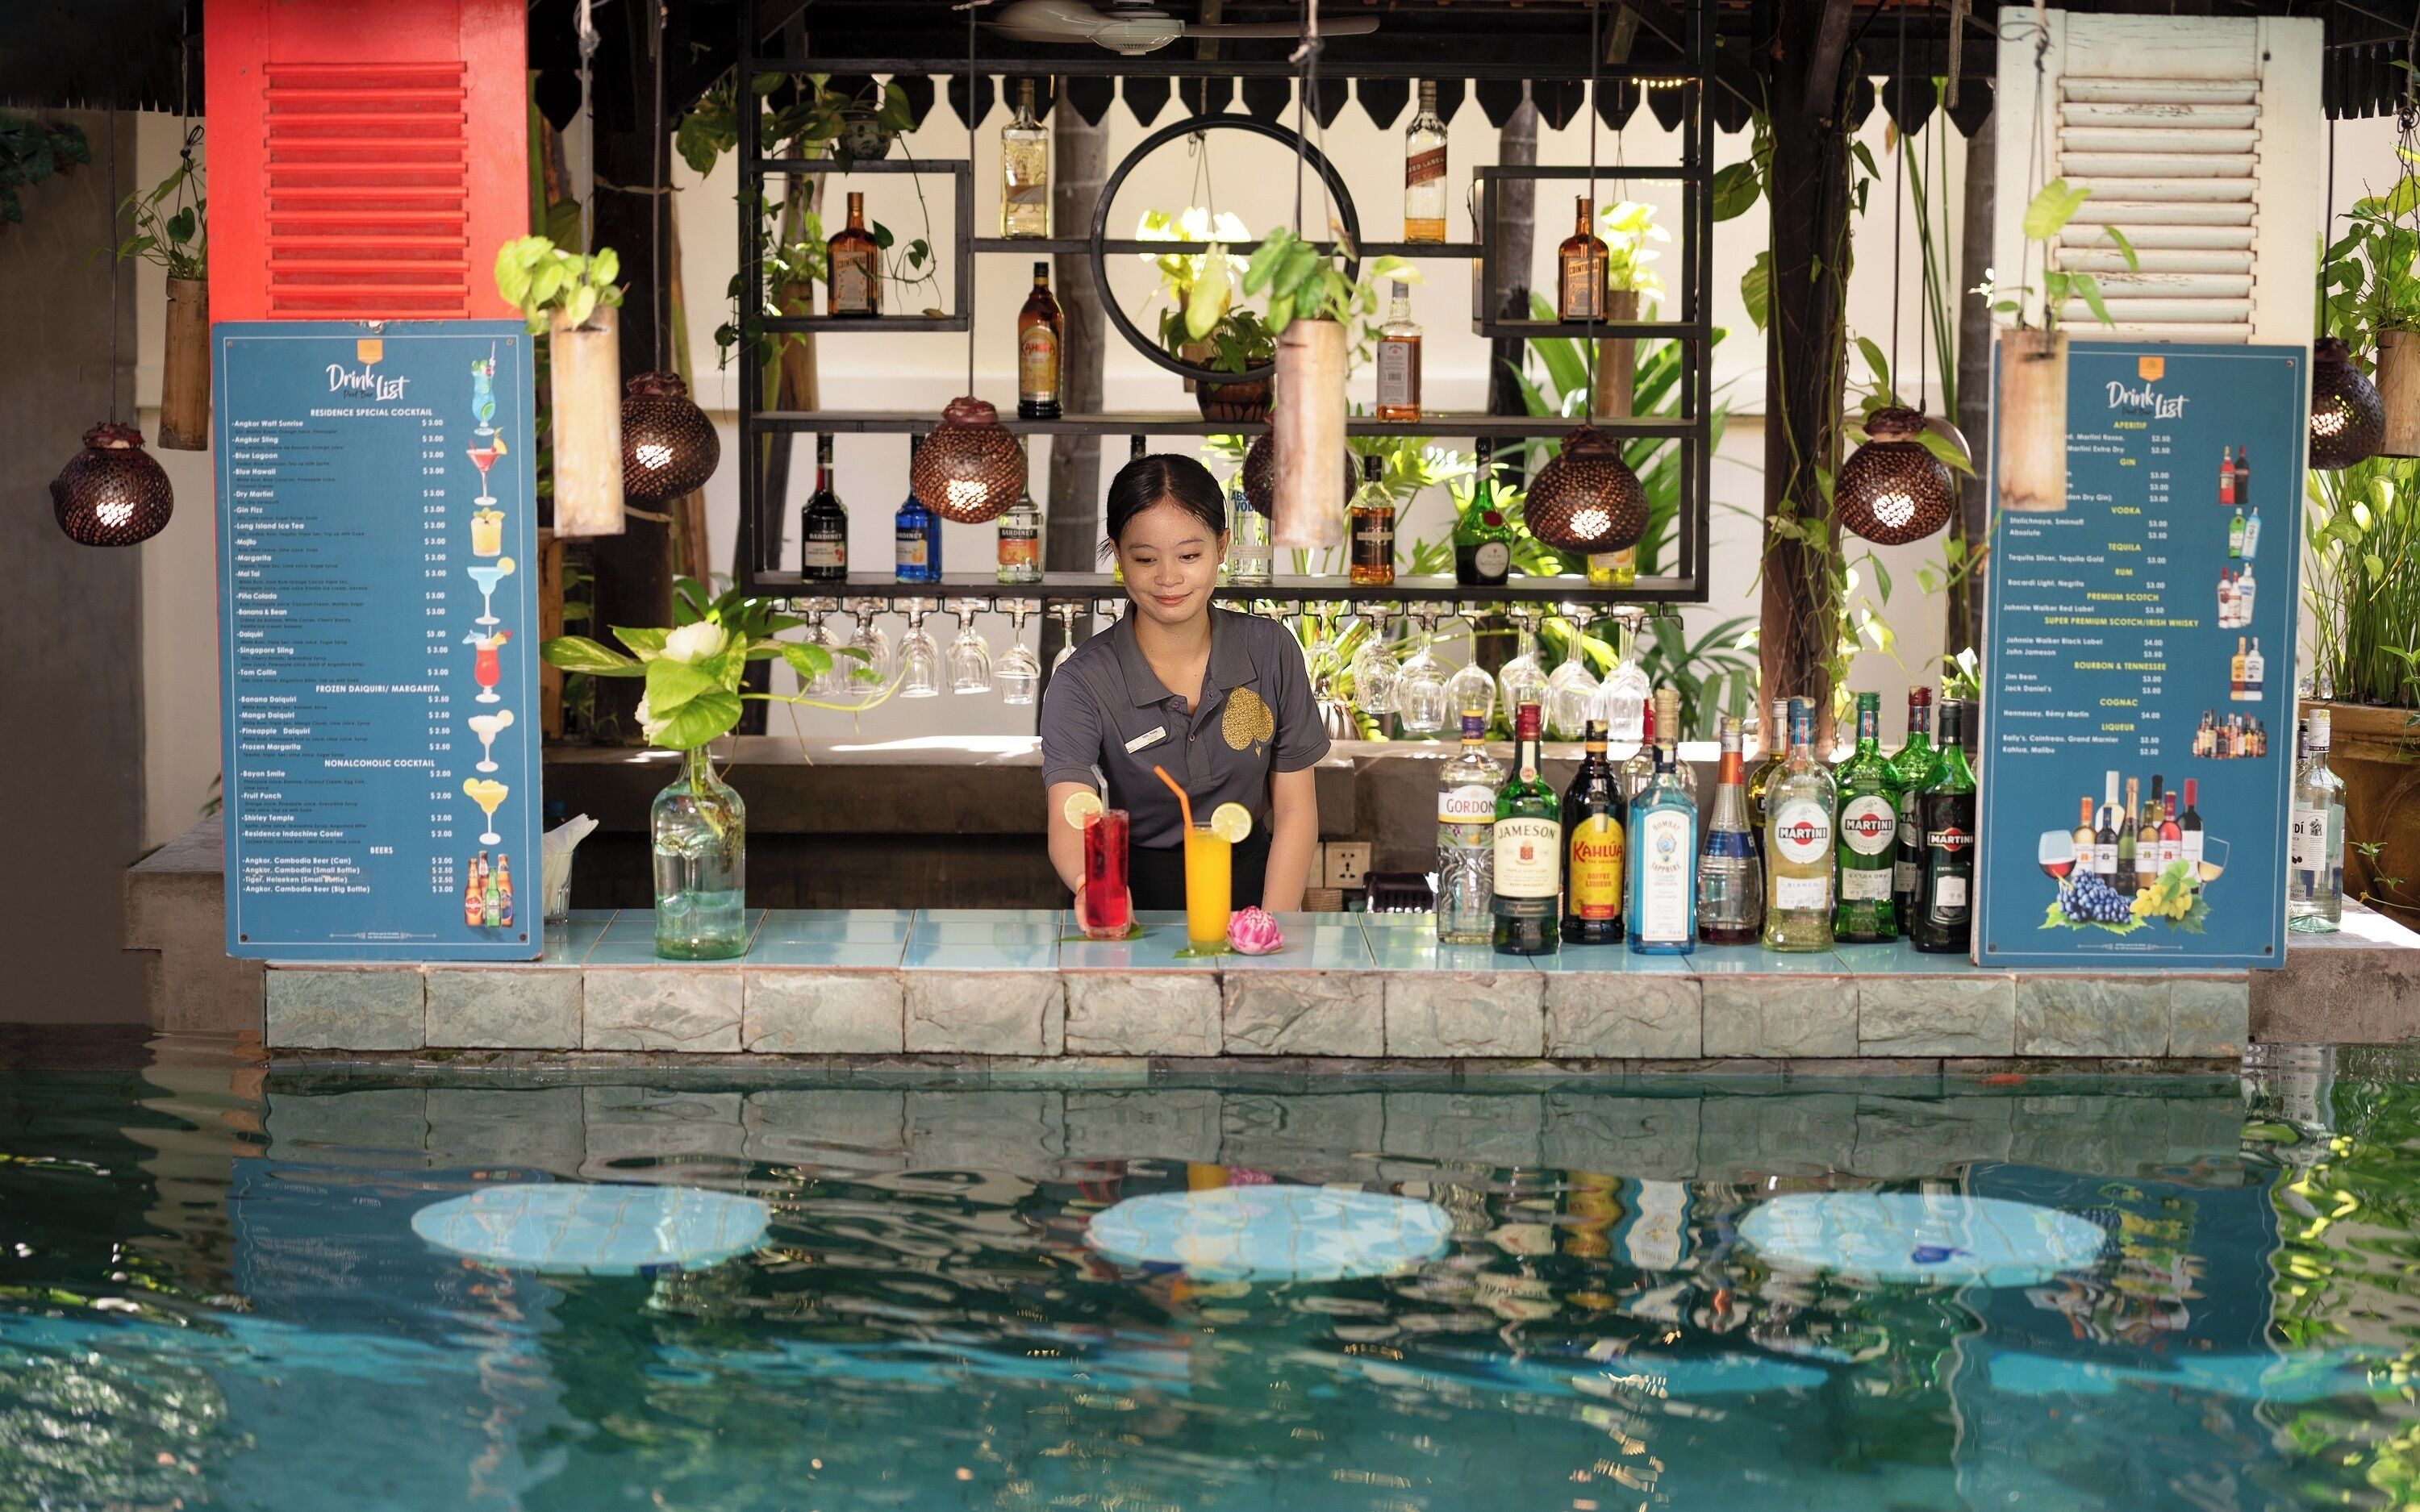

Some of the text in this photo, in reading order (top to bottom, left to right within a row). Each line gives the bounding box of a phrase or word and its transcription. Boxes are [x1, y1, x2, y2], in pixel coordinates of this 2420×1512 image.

[1422, 156, 1444, 168] LABEL
[1568, 261, 1599, 275] COINTRAU
[326, 364, 411, 402] Drink List
[2105, 381, 2190, 419] Drink List
[2113, 421, 2147, 429] APERITIF
[2119, 458, 2136, 466] GIN
[1234, 501, 1255, 512] VOD
[809, 532, 842, 540] BARDINET
[1001, 529, 1034, 537] BARDINET
[2059, 555, 2085, 563] Tequila
[2071, 618, 2107, 626] PREMIUM
[277, 647, 294, 655] Sling
[2074, 661, 2114, 669] BOURBON
[2100, 698, 2138, 706] COGNAC
[283, 727, 311, 735] Daiquiri
[266, 744, 301, 752] Margarita
[269, 814, 294, 823] Temple
[1652, 819, 1681, 831] BOMBAY
[1846, 819, 1892, 831] MARTINI
[1498, 824, 1556, 840] JAMESON
[1780, 827, 1827, 839] MARTINI
[1930, 835, 1974, 844] MARTINI
[1573, 840, 1624, 863] KAHLÚA
[301, 876, 322, 884] (Small
[331, 885, 345, 893] (Big
[347, 885, 370, 893] Bottle)
